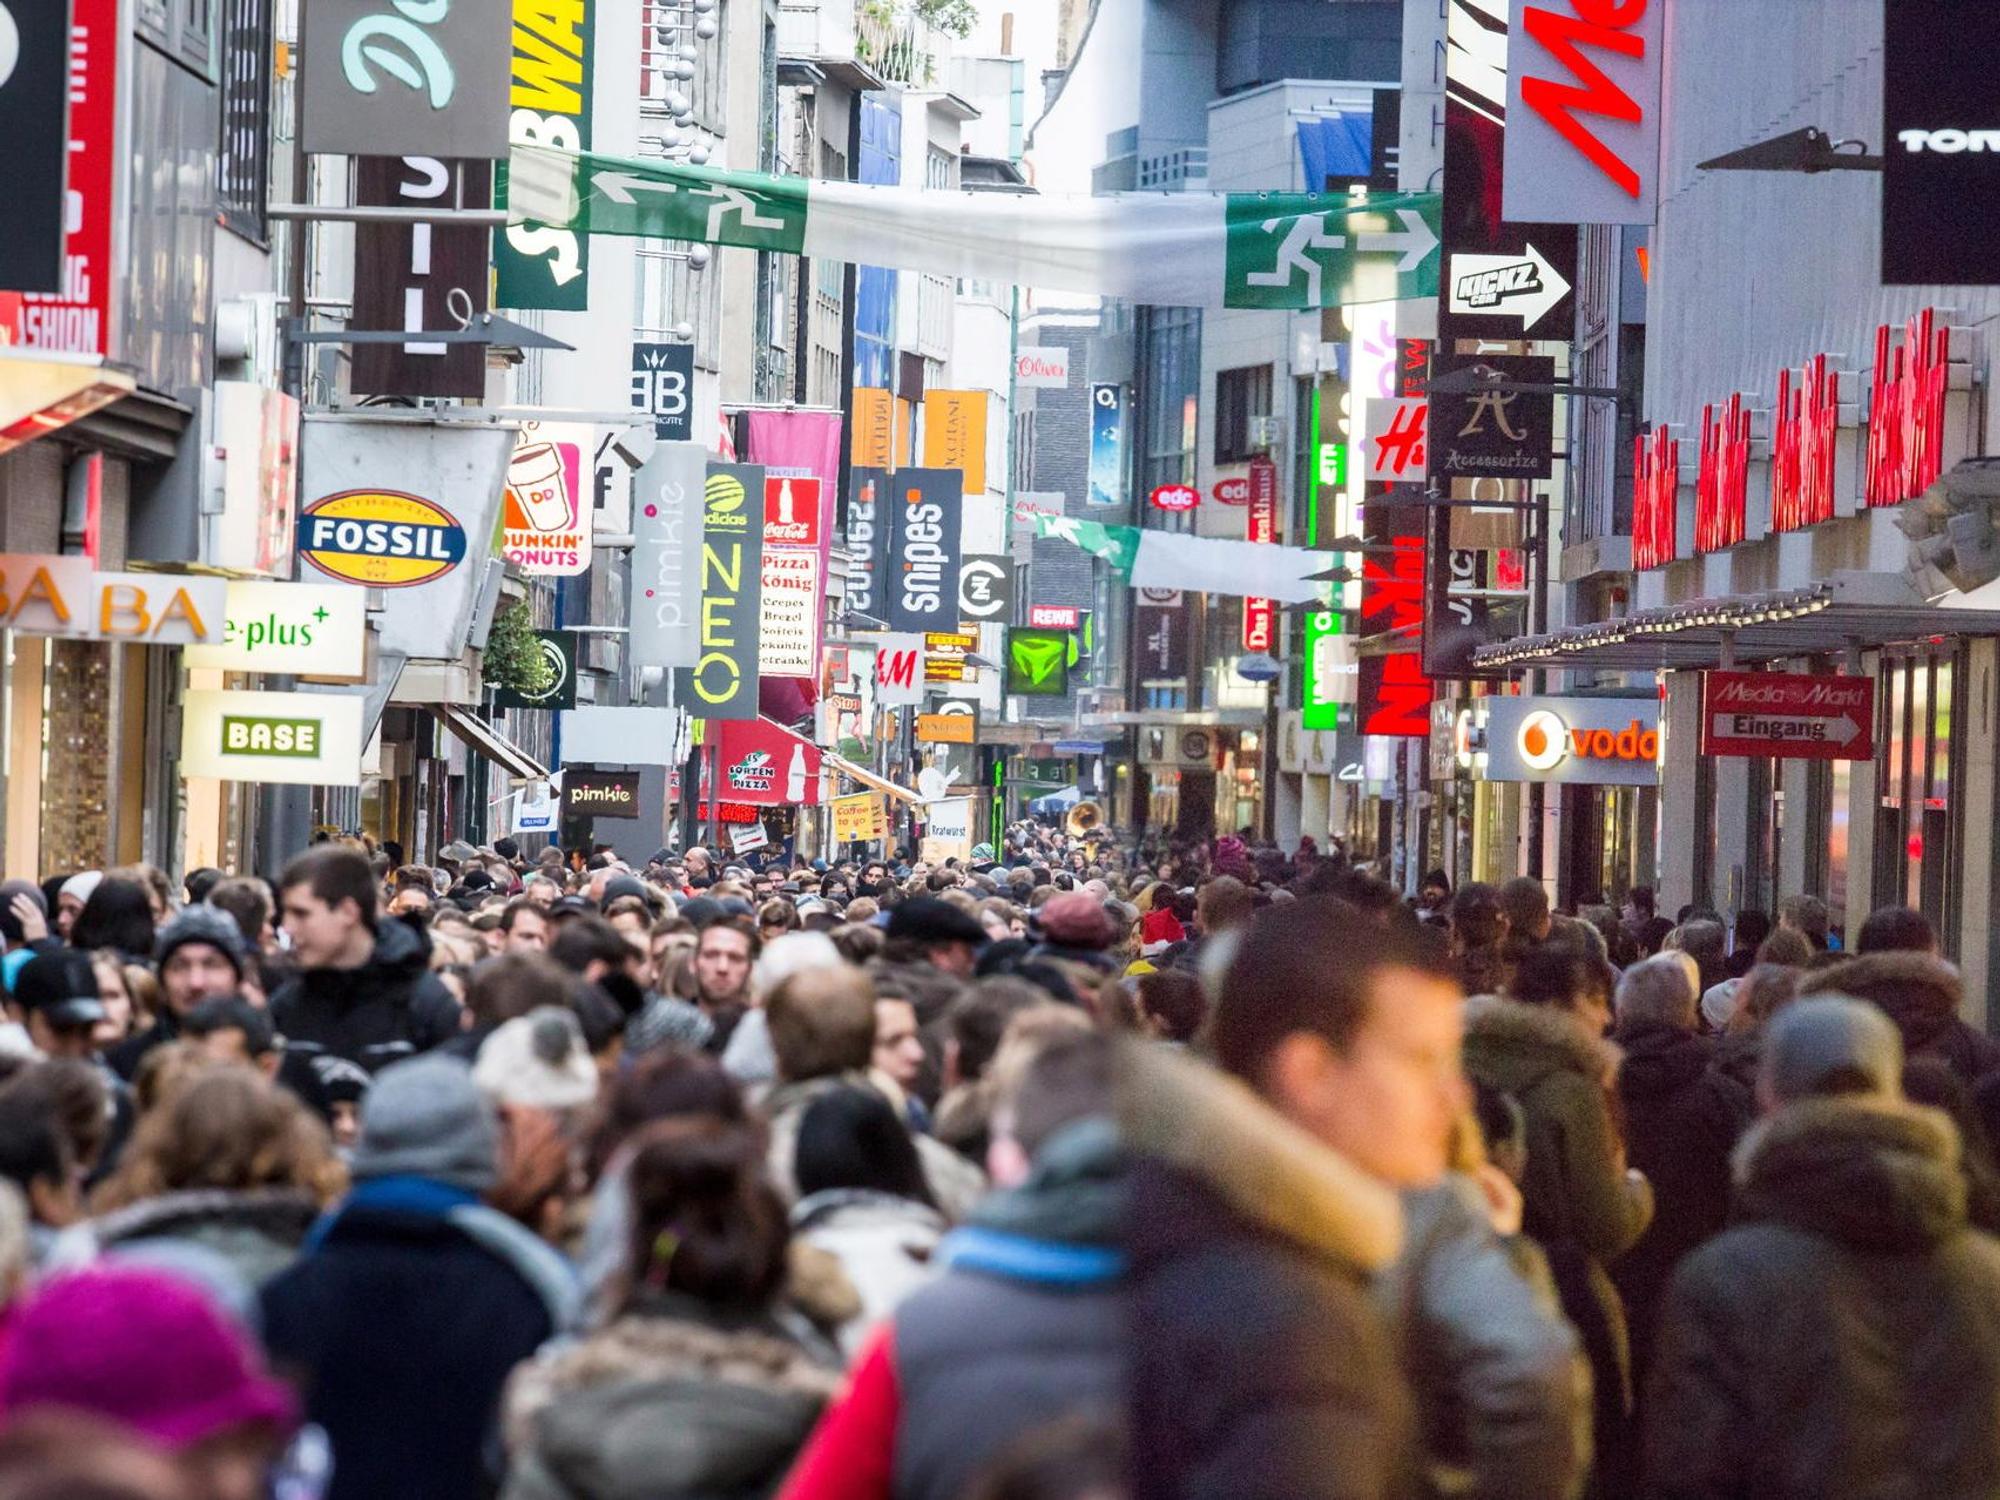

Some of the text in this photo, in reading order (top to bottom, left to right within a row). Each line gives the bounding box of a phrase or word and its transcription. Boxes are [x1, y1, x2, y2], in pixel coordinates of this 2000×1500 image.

[1444, 449, 1539, 470] Accessorize
[1158, 488, 1193, 505] edc
[1221, 482, 1248, 500] ed
[1253, 467, 1272, 543] teakhaus
[704, 512, 748, 526] didas
[313, 519, 451, 559] FOSSIL
[508, 550, 578, 566] ONUTS
[644, 481, 688, 629] pimkie
[762, 555, 809, 570] Pizza
[902, 504, 949, 613] snipes
[764, 611, 802, 622] Brezel
[1250, 613, 1269, 647] Das
[760, 640, 808, 651] ekühlte
[760, 656, 809, 666] etränke
[1714, 680, 1866, 706] Media Markt
[228, 721, 315, 752] BASE
[1733, 714, 1826, 741] Eingang
[729, 765, 774, 777] SORTEN
[571, 783, 631, 804] pimkie
[733, 780, 769, 790] PIZZA
